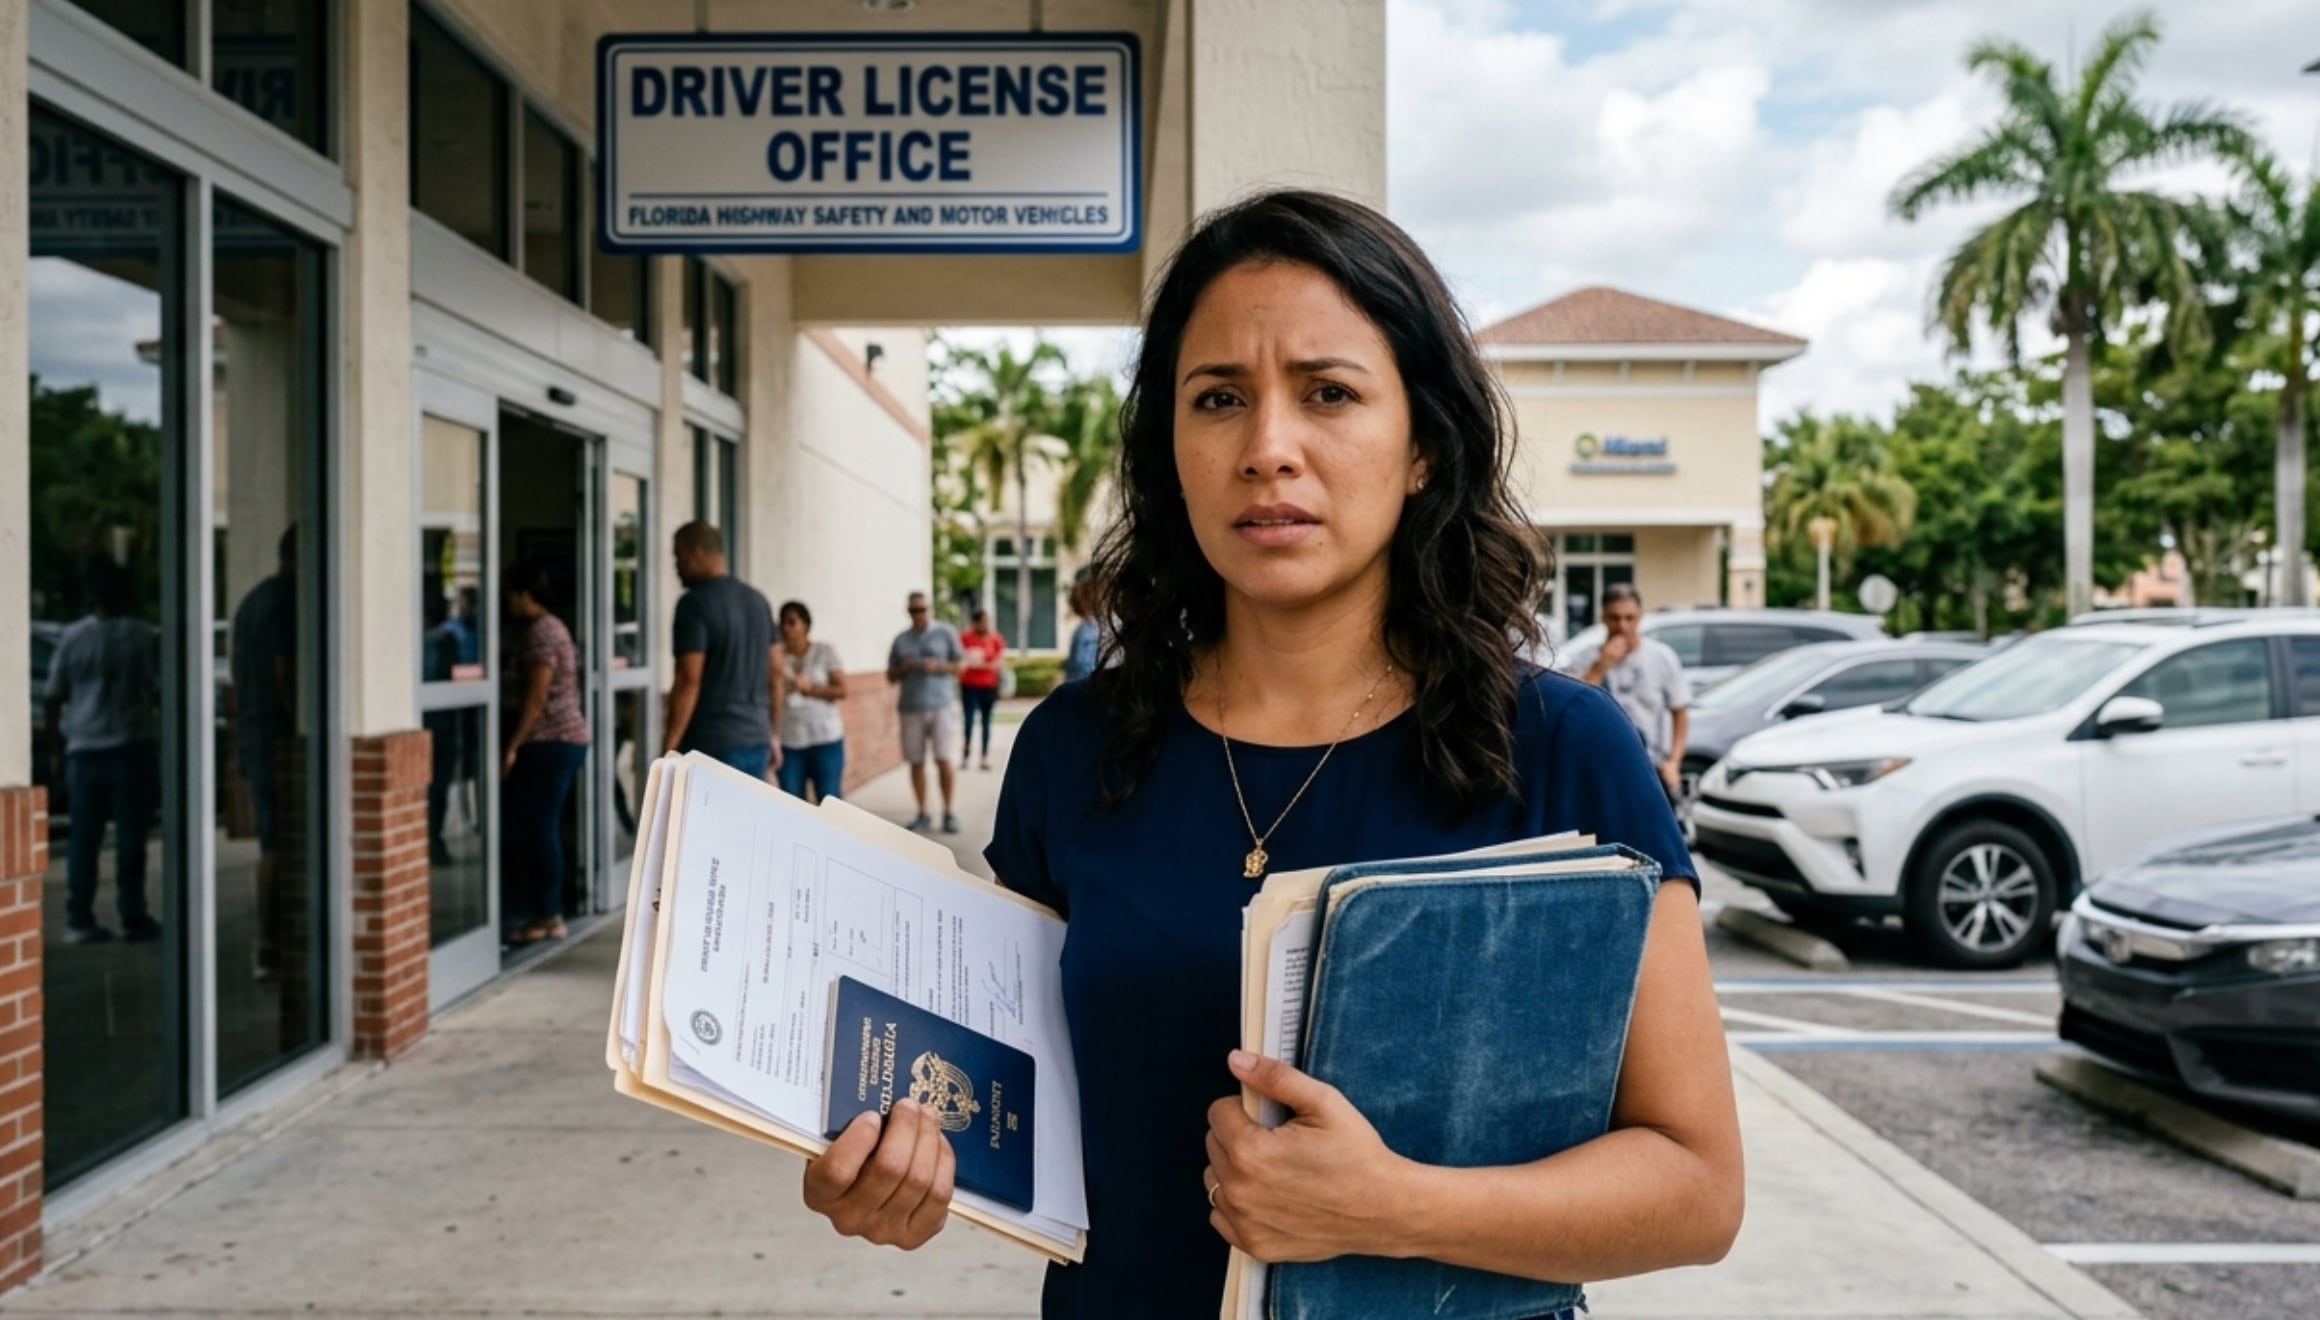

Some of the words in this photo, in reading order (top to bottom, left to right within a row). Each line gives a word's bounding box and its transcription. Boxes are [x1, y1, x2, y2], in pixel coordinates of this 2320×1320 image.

[630, 64, 845, 118] DRIVER
[864, 64, 1107, 118] LICENSE
[767, 130, 971, 182] OFFICE
[628, 206, 712, 227] FLORIDA
[716, 206, 806, 227] HIGHWAY
[814, 205, 887, 227] SAFETY
[894, 205, 933, 226] AND
[940, 205, 1008, 226] MOTOR
[1015, 204, 1109, 226] VEHICLES
